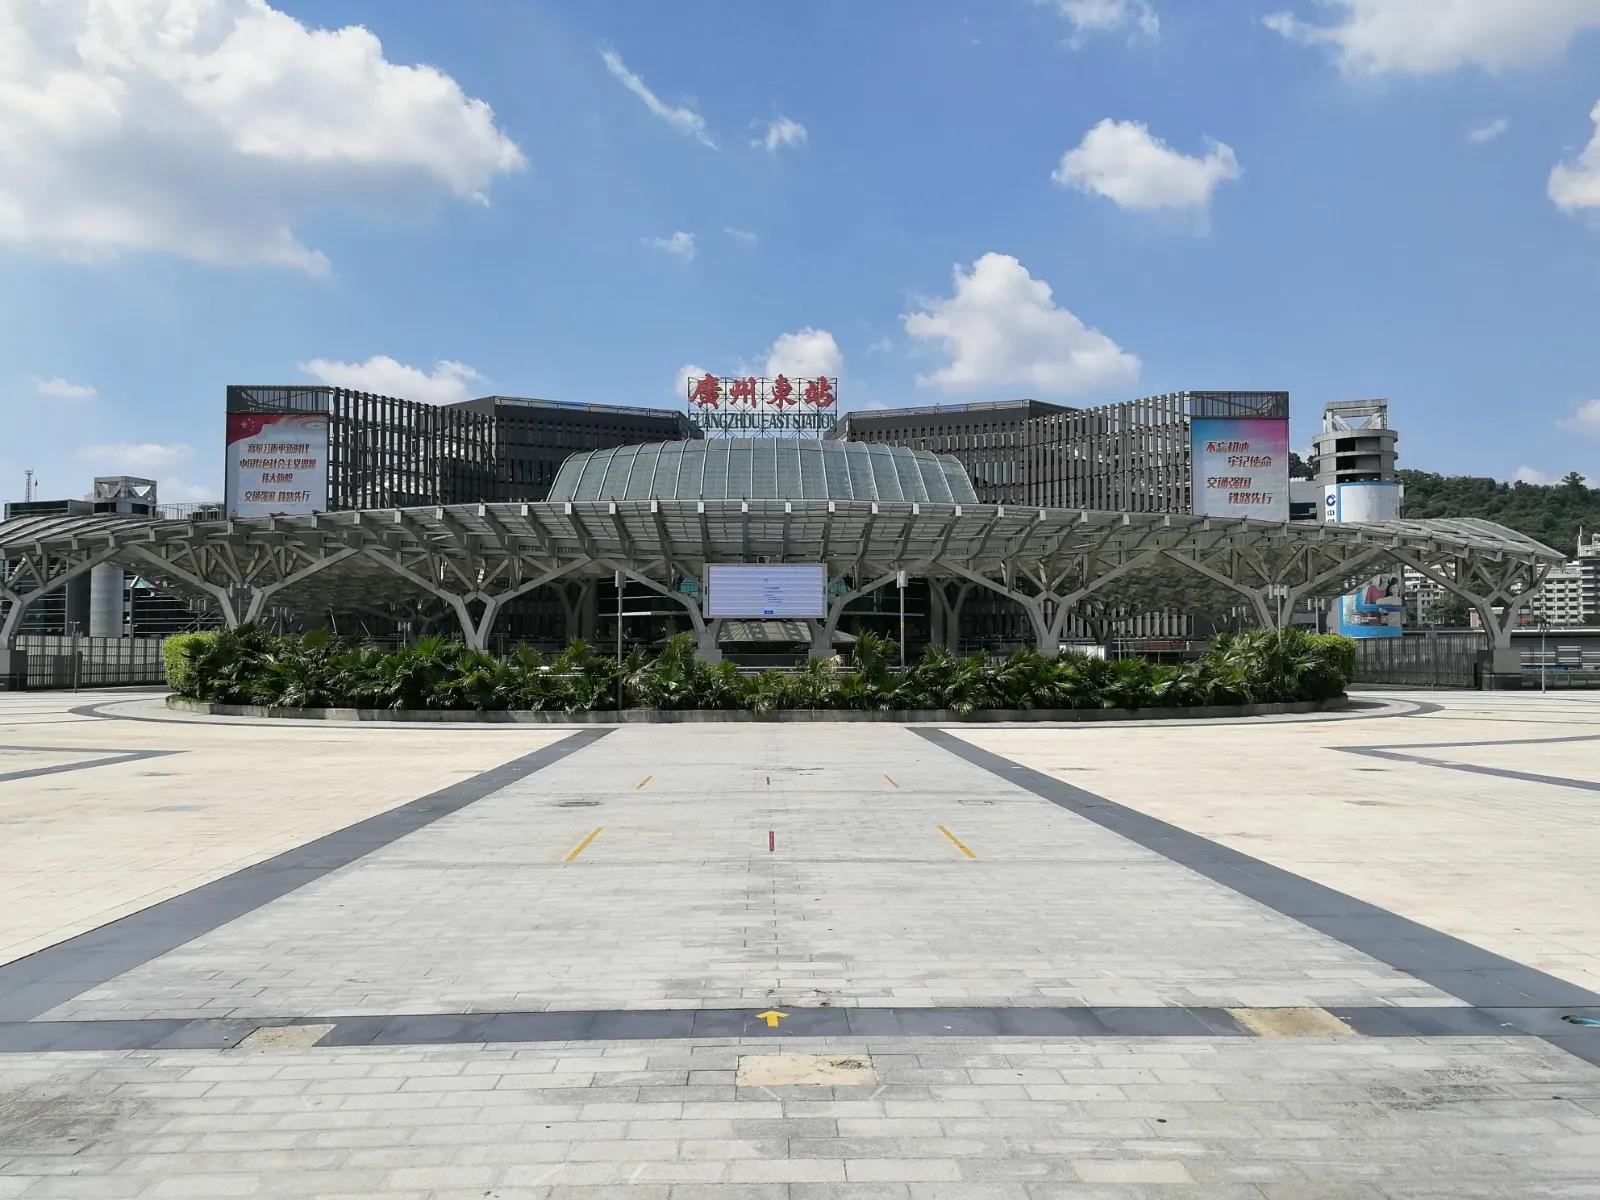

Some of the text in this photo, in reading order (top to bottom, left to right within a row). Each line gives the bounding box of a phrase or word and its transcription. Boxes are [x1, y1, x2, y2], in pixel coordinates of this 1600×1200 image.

[690, 373, 835, 409] 廣州東站
[689, 413, 837, 429] GUANGZHOU EAST STATION
[1227, 455, 1272, 467] 牢记使命
[1206, 476, 1252, 489] 交通强国
[1228, 492, 1273, 504] 铁路先行
